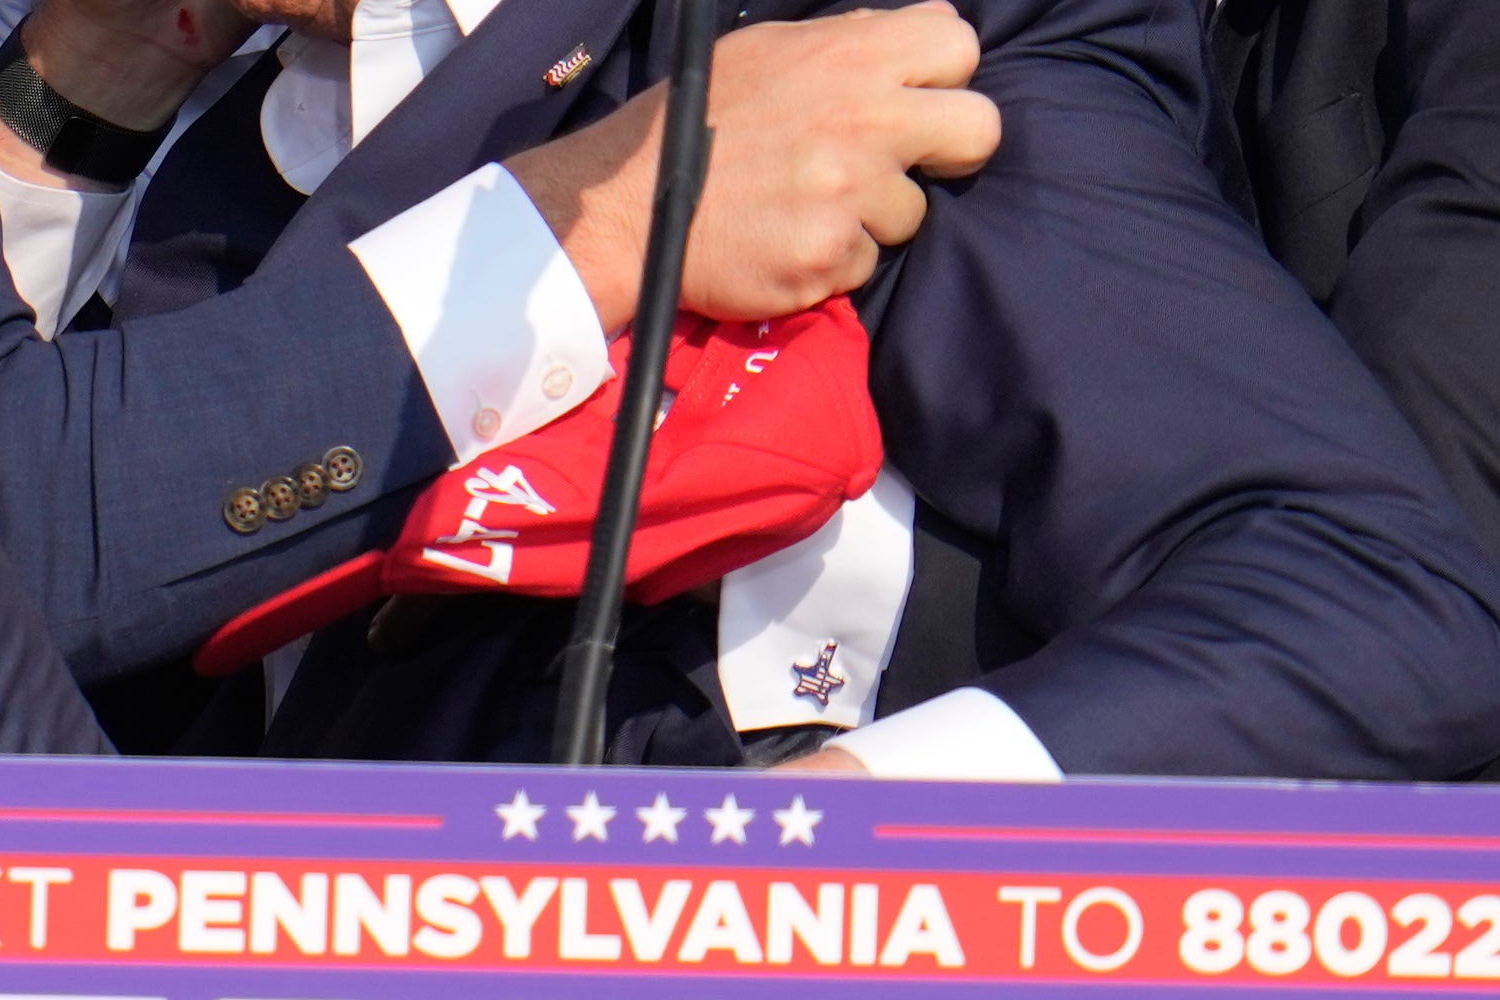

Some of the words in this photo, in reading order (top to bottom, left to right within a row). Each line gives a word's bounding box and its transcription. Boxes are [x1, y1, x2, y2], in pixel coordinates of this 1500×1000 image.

[106, 869, 965, 968] PENNSYLVANIA
[997, 886, 1143, 972] TO
[1178, 889, 1500, 977] 88022
